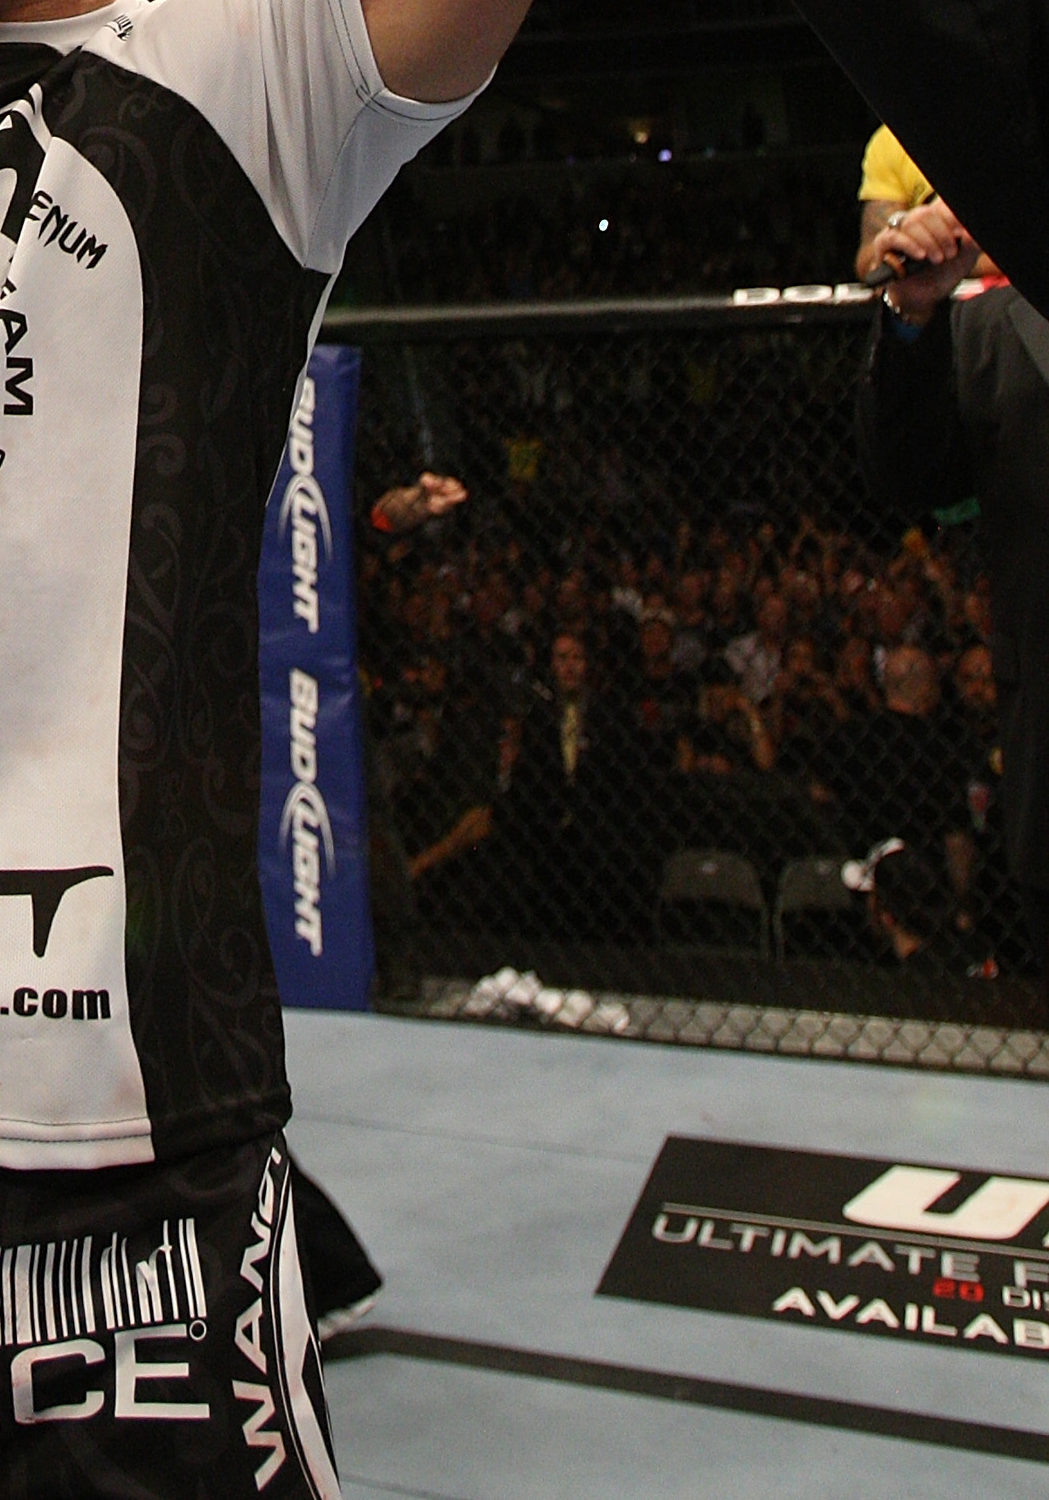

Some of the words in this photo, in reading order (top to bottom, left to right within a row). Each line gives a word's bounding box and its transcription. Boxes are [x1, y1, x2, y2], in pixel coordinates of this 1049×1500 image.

[25, 190, 108, 270] ENUM
[291, 490, 320, 635] LIGHT
[289, 666, 318, 784] BUD
[292, 799, 324, 958] LIGHT
[843, 1163, 1049, 1247] U
[652, 1213, 981, 1283] ULTIMATE
[1002, 1285, 1049, 1312] DI
